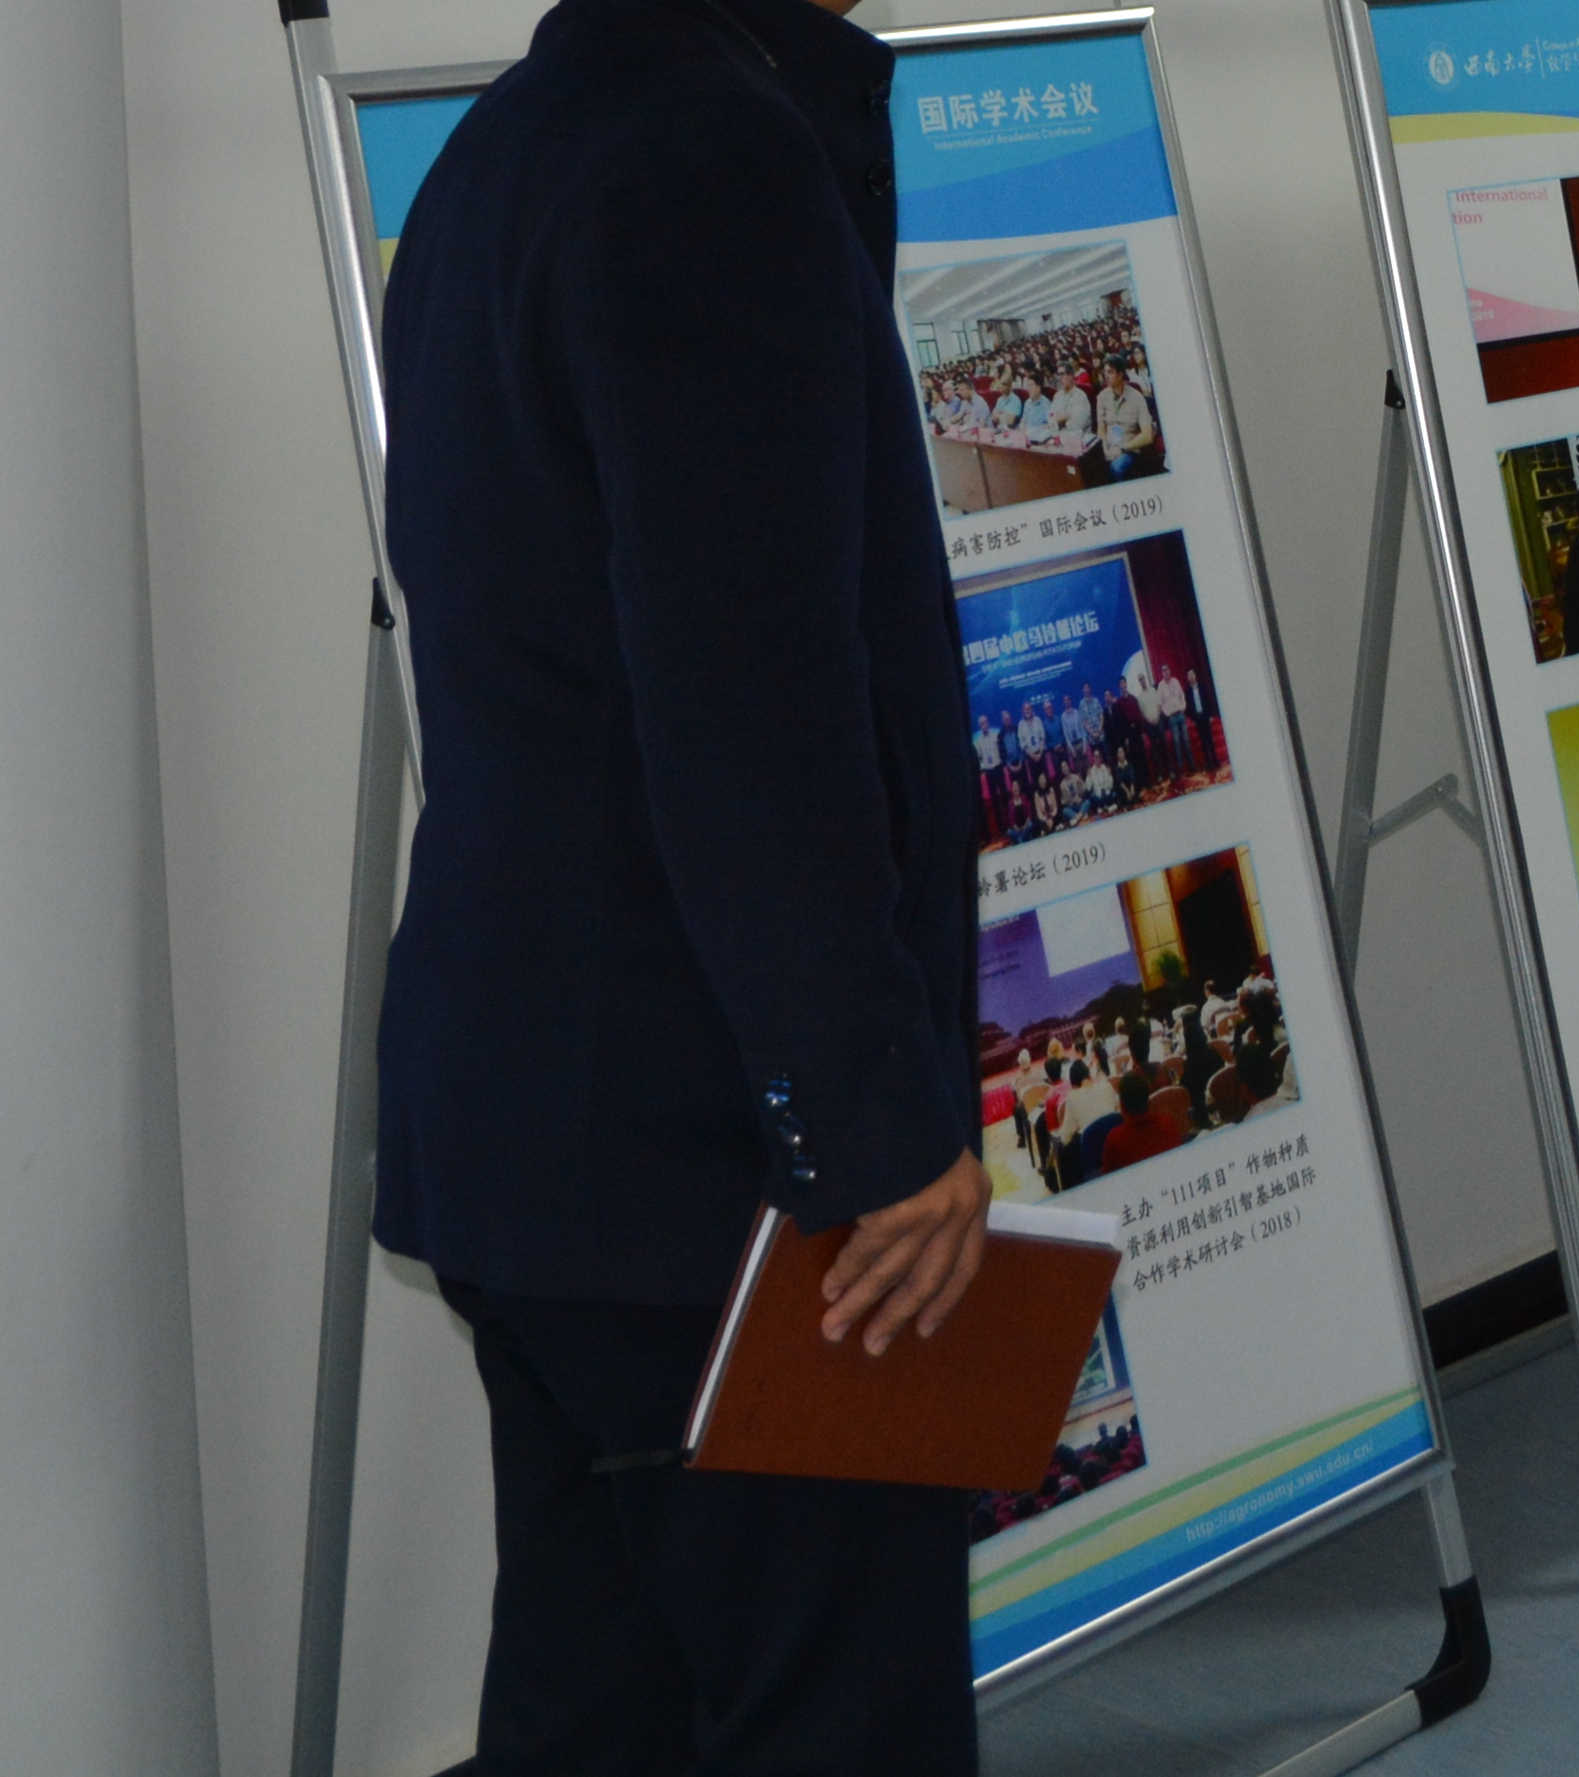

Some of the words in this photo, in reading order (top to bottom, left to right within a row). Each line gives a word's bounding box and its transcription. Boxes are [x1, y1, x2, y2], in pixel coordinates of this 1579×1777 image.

[917, 81, 1099, 134] 国际学术会议
[1455, 186, 1549, 202] International
[1126, 1166, 1317, 1261] 资源利用创新引智基地国际
